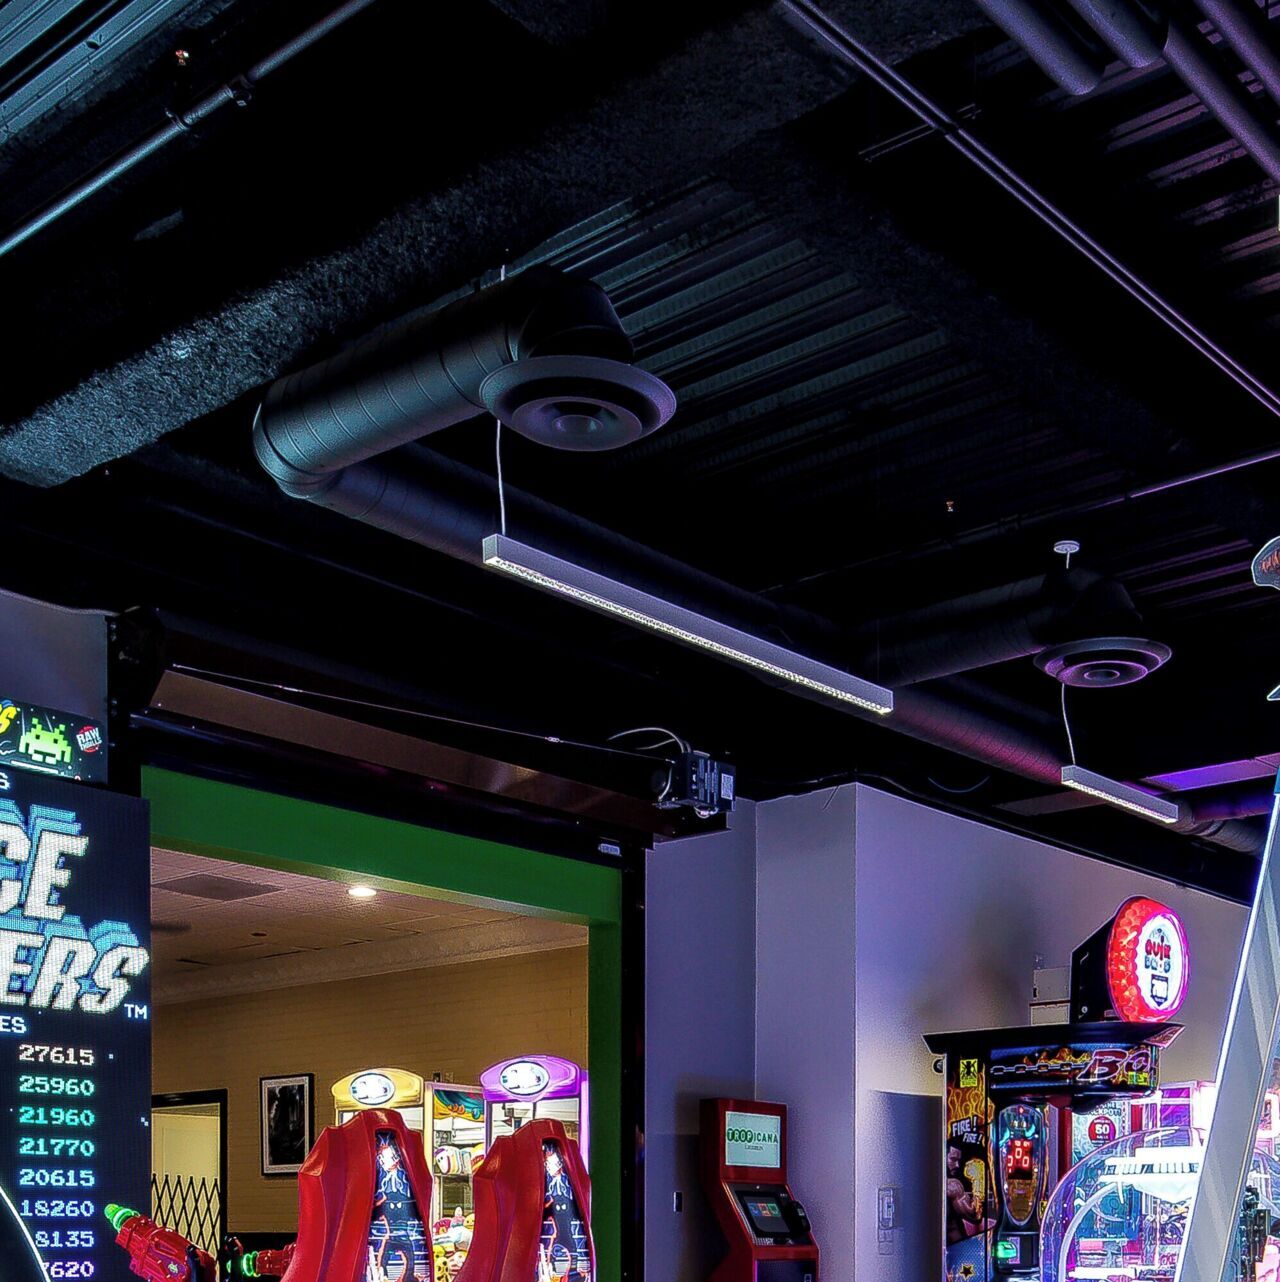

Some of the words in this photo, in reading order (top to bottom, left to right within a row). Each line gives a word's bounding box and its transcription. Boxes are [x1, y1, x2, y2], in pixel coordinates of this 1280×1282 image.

[19, 1044, 94, 1066] 27615
[19, 1075, 94, 1096] 25960
[19, 1106, 95, 1126] 21960
[727, 1127, 779, 1143] TROPICANA
[952, 1116, 978, 1137] FIRE!
[19, 1138, 95, 1157] 21770
[19, 1169, 95, 1187] 20615
[19, 1200, 95, 1217] 18260
[35, 1231, 95, 1248] 8135
